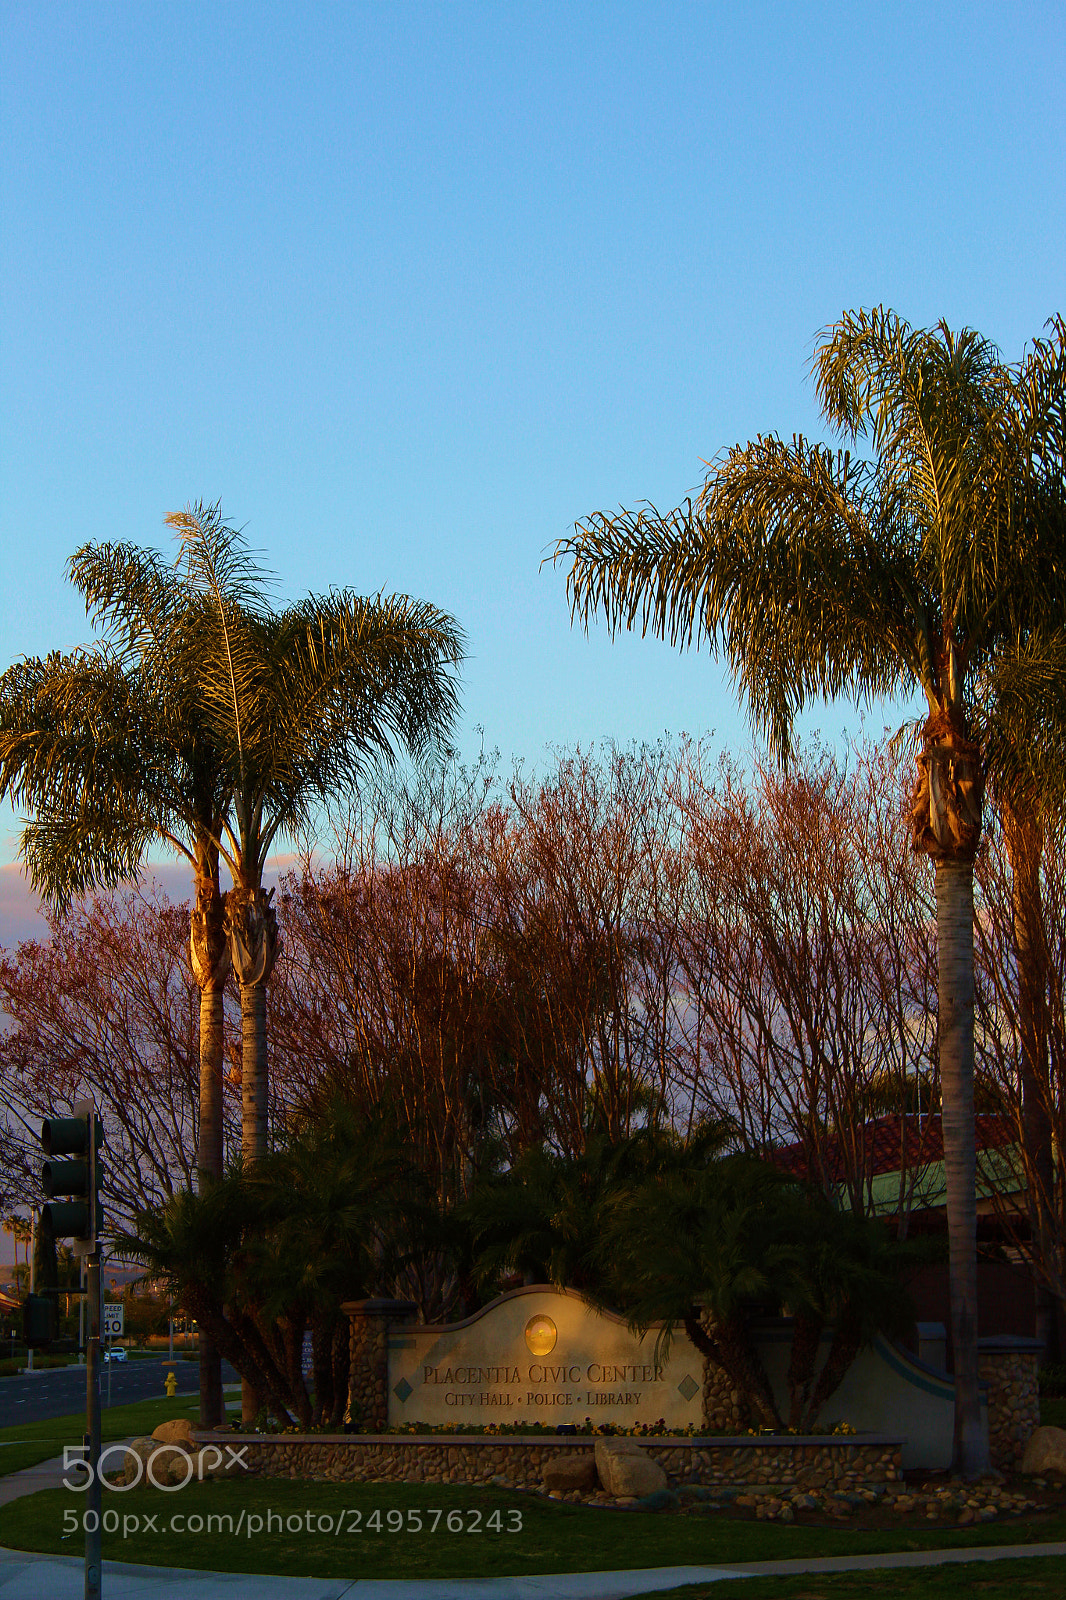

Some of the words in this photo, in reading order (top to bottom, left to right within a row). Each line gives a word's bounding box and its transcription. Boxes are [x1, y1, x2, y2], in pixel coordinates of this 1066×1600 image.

[104, 1320, 122, 1332] 40
[423, 1365, 521, 1384] PLACENTIA
[528, 1364, 581, 1383] CIVIC
[587, 1363, 665, 1383] CENTER
[445, 1392, 476, 1406] CITY
[479, 1392, 513, 1406] HALL
[526, 1392, 573, 1405] POLICE
[586, 1391, 642, 1405] LIBRARY
